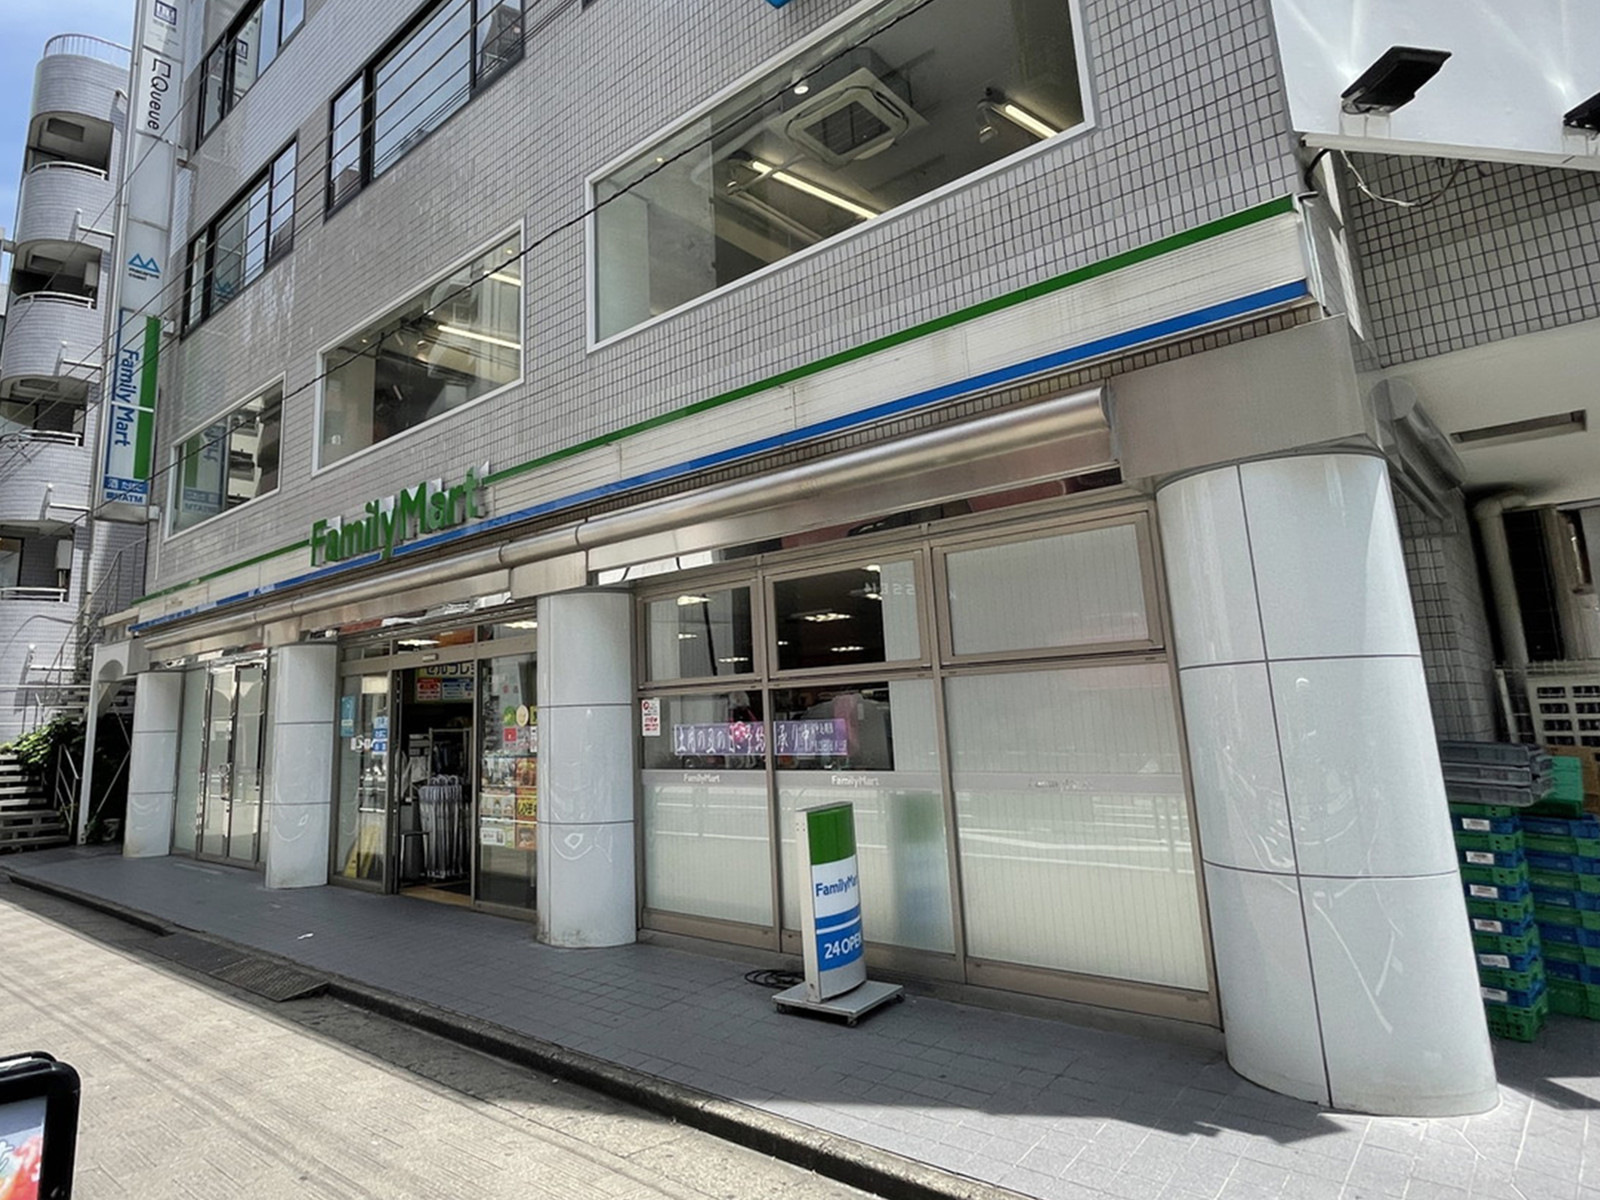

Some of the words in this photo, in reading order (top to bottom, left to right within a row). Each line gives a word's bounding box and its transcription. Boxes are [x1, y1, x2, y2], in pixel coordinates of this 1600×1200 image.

[147, 76, 169, 130] Queue
[115, 349, 139, 446] FamilyMart
[311, 464, 486, 567] FamilyMart
[427, 662, 474, 675] セルフレ
[831, 774, 879, 788] FamilyMart
